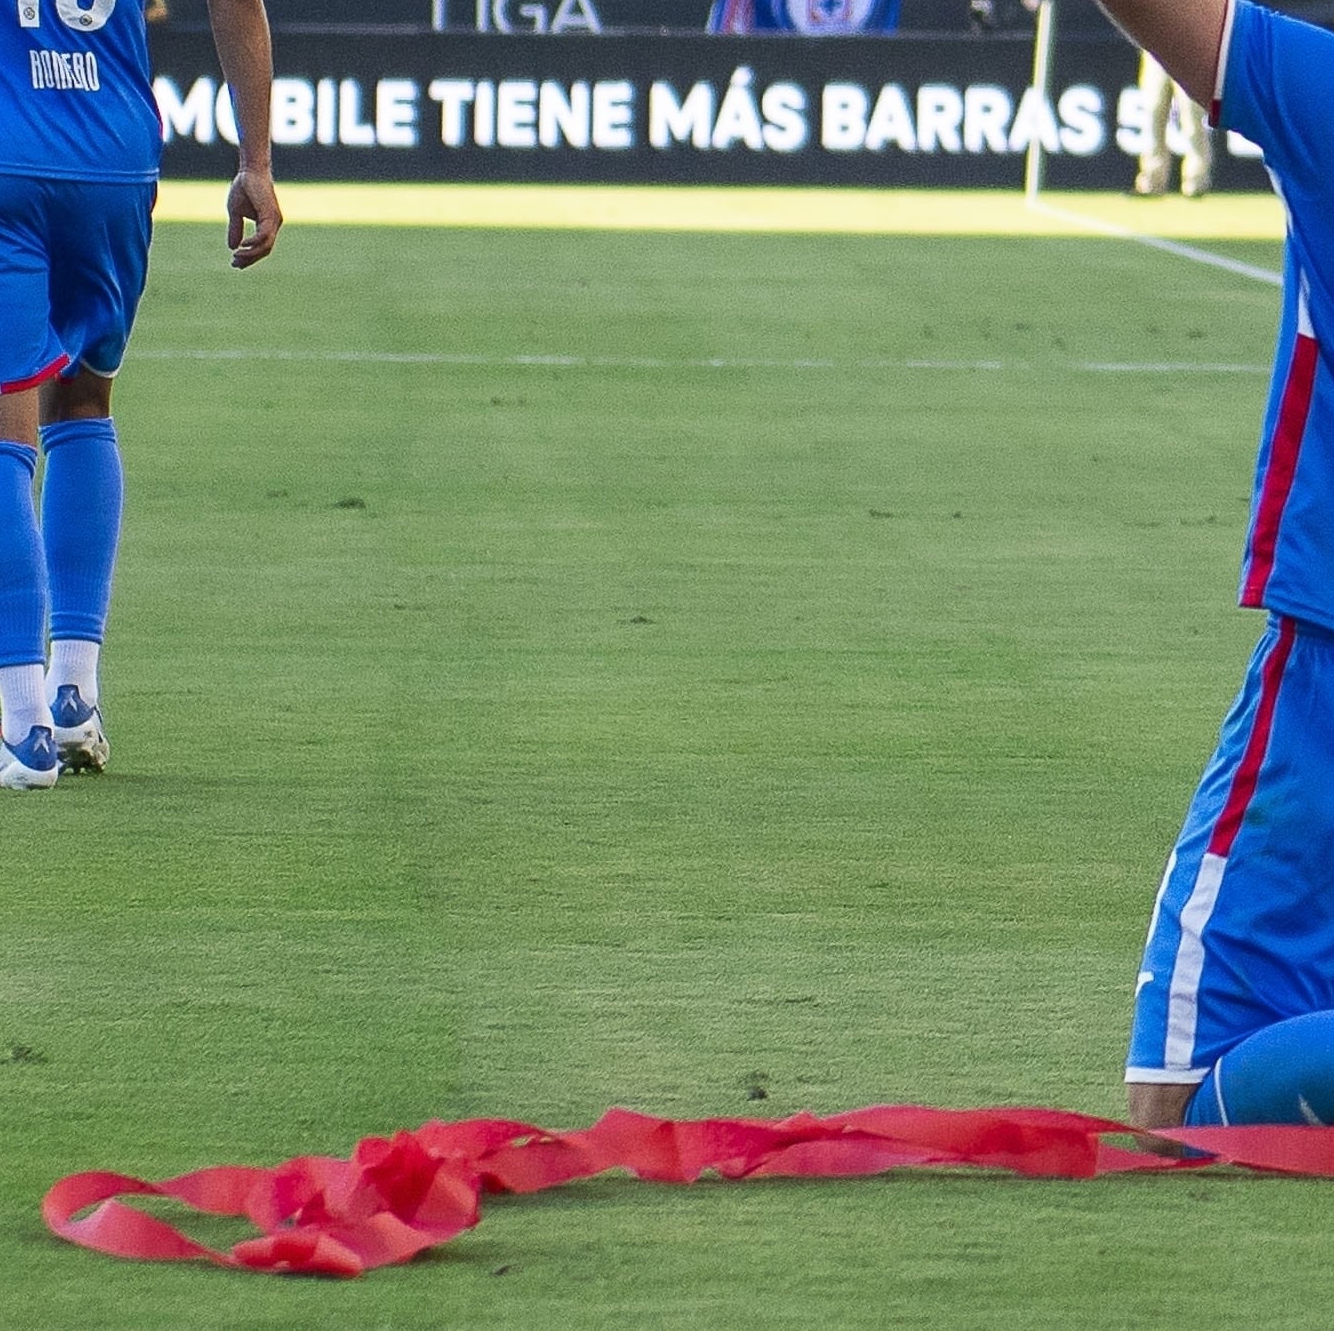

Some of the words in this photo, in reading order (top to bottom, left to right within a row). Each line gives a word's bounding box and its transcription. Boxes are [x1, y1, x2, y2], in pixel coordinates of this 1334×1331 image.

[429, 79, 636, 150] TIENE
[648, 66, 807, 151] MÁS
[821, 82, 1104, 156] BARRAS
